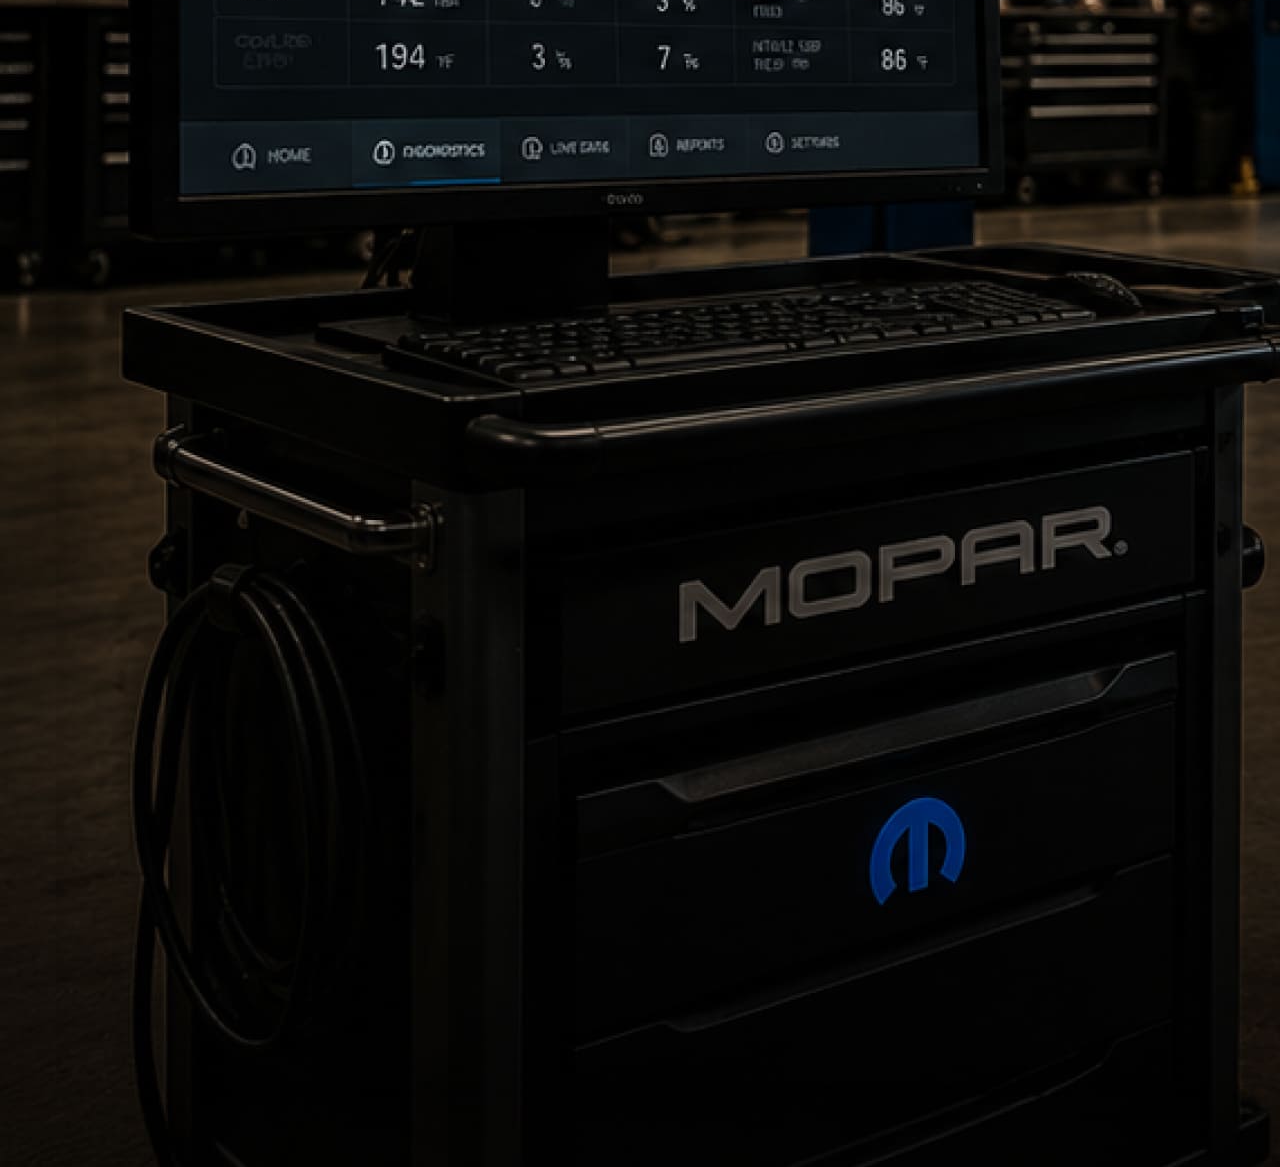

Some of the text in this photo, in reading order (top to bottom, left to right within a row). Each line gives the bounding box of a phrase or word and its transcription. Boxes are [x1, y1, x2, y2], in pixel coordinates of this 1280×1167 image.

[375, 42, 426, 71] 194
[531, 42, 547, 71] 3
[656, 44, 672, 71] 7
[880, 48, 908, 72] 86
[267, 146, 312, 165] HOME
